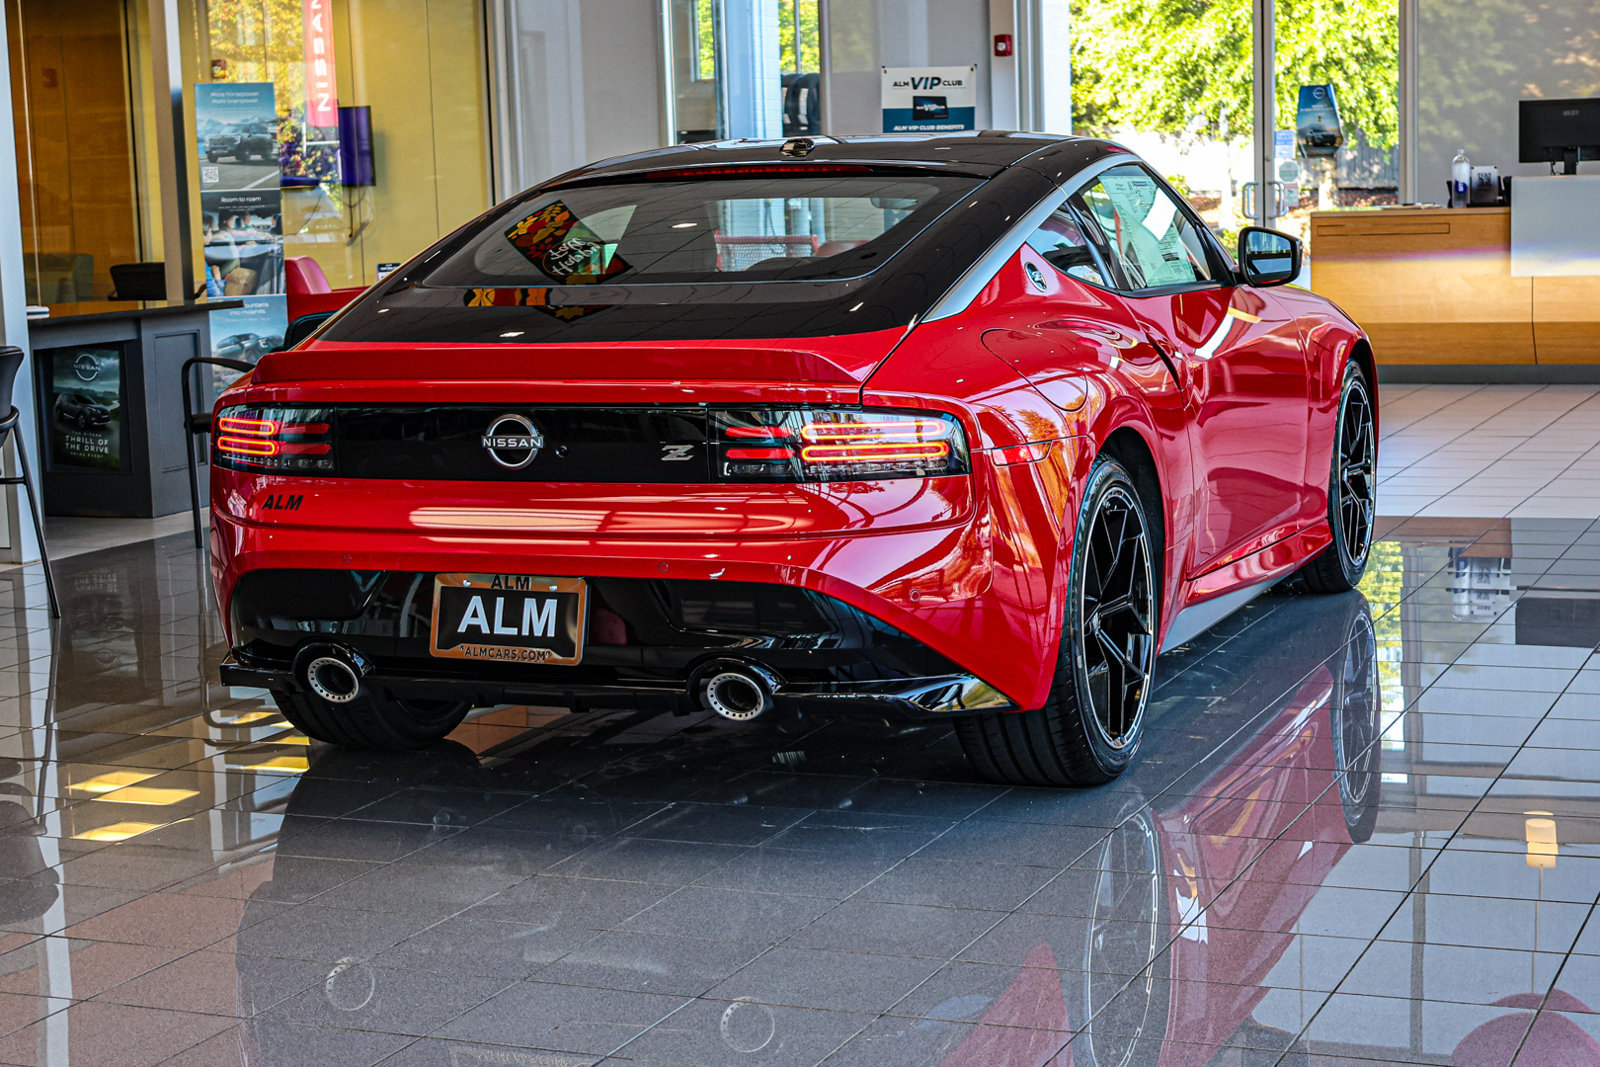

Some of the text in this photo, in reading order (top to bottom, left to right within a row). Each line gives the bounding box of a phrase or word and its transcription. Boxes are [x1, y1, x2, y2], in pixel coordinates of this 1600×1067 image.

[311, 0, 332, 112] NISSAN
[910, 76, 942, 90] VIP
[73, 363, 101, 371] NISSAN
[65, 435, 95, 445] THRILL
[482, 437, 542, 448] NISSAN
[65, 442, 110, 454] THE DRIVE
[661, 444, 694, 461] Z
[261, 494, 304, 511] ALM
[491, 575, 531, 590] ALM
[457, 595, 558, 637] ALM
[464, 646, 546, 661] ALMCARS.COM
